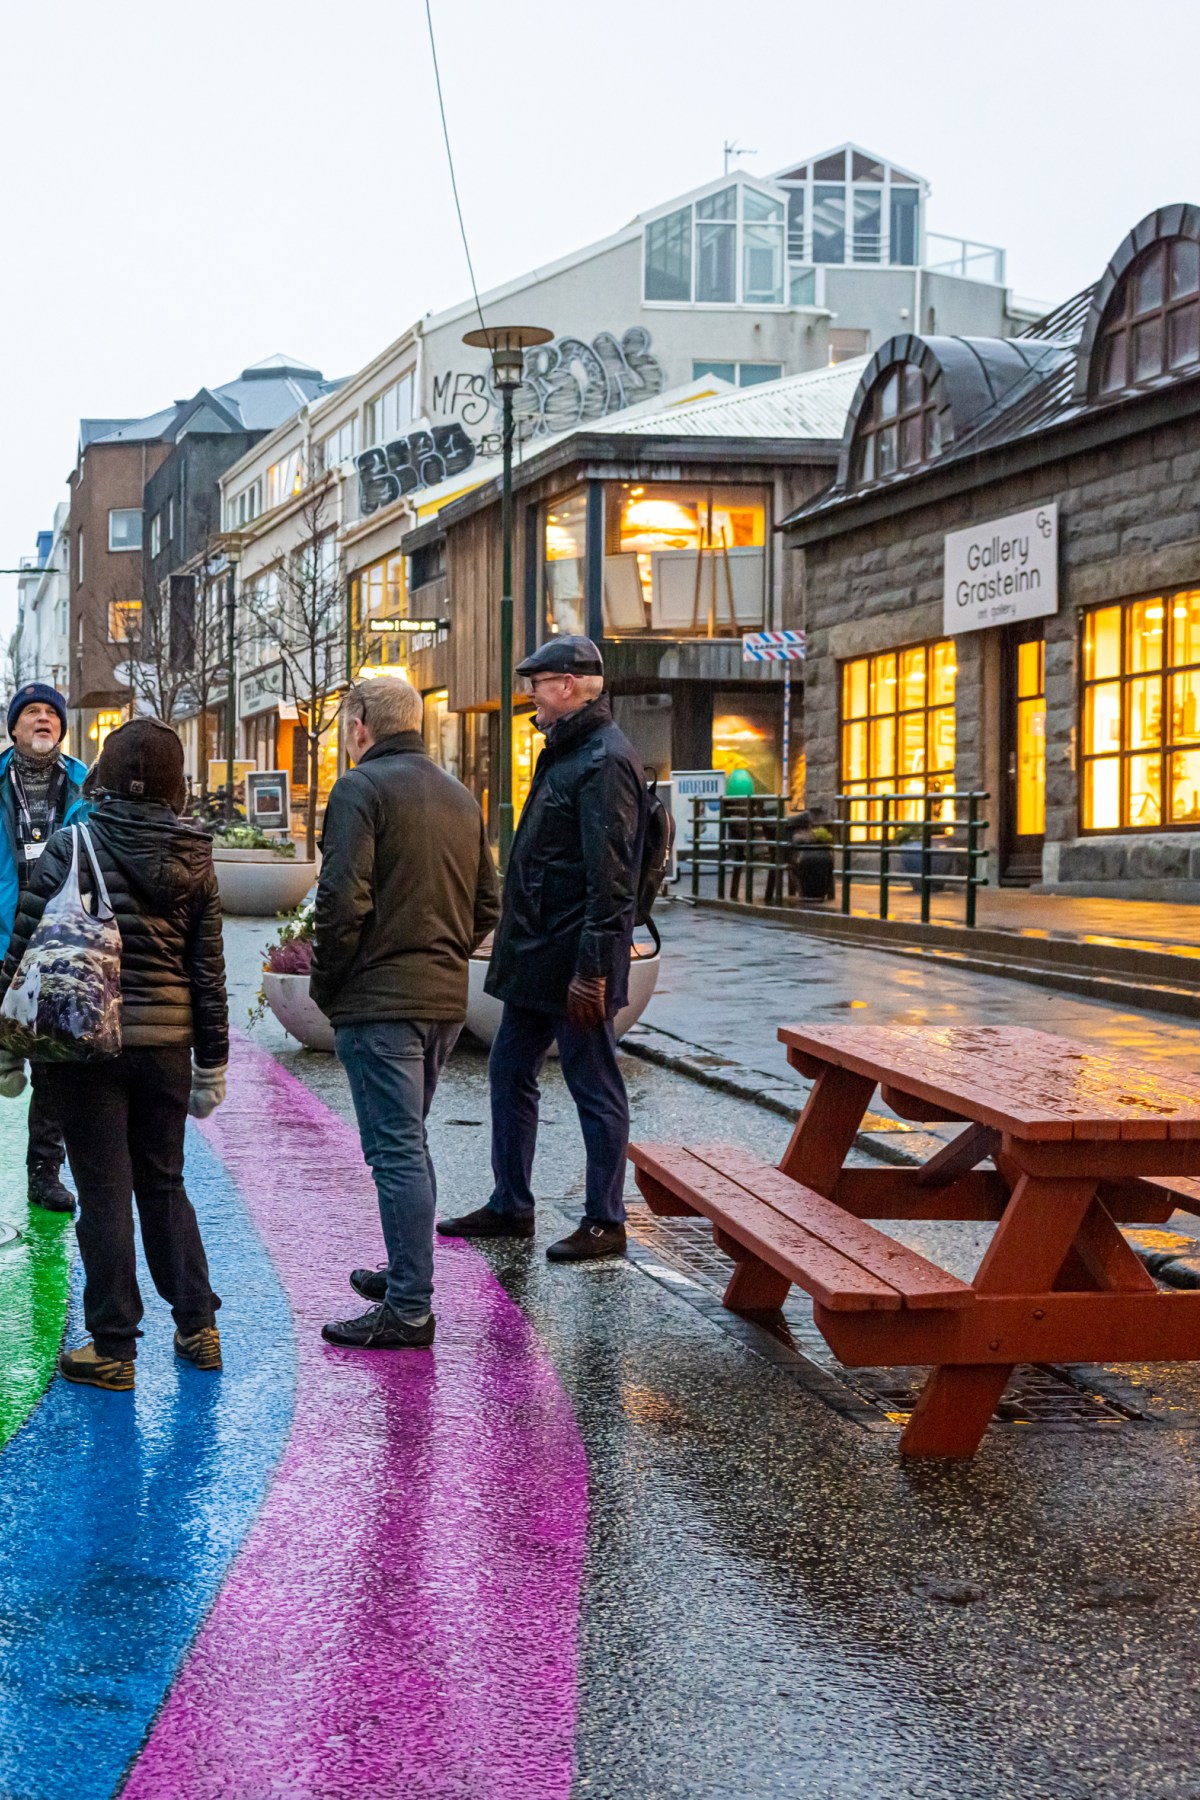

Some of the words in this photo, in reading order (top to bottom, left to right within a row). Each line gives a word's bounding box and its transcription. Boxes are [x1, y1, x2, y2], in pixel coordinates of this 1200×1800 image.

[967, 535, 1029, 572] Gallery
[956, 566, 1042, 608] Grásteinn
[421, 621, 436, 631] art
